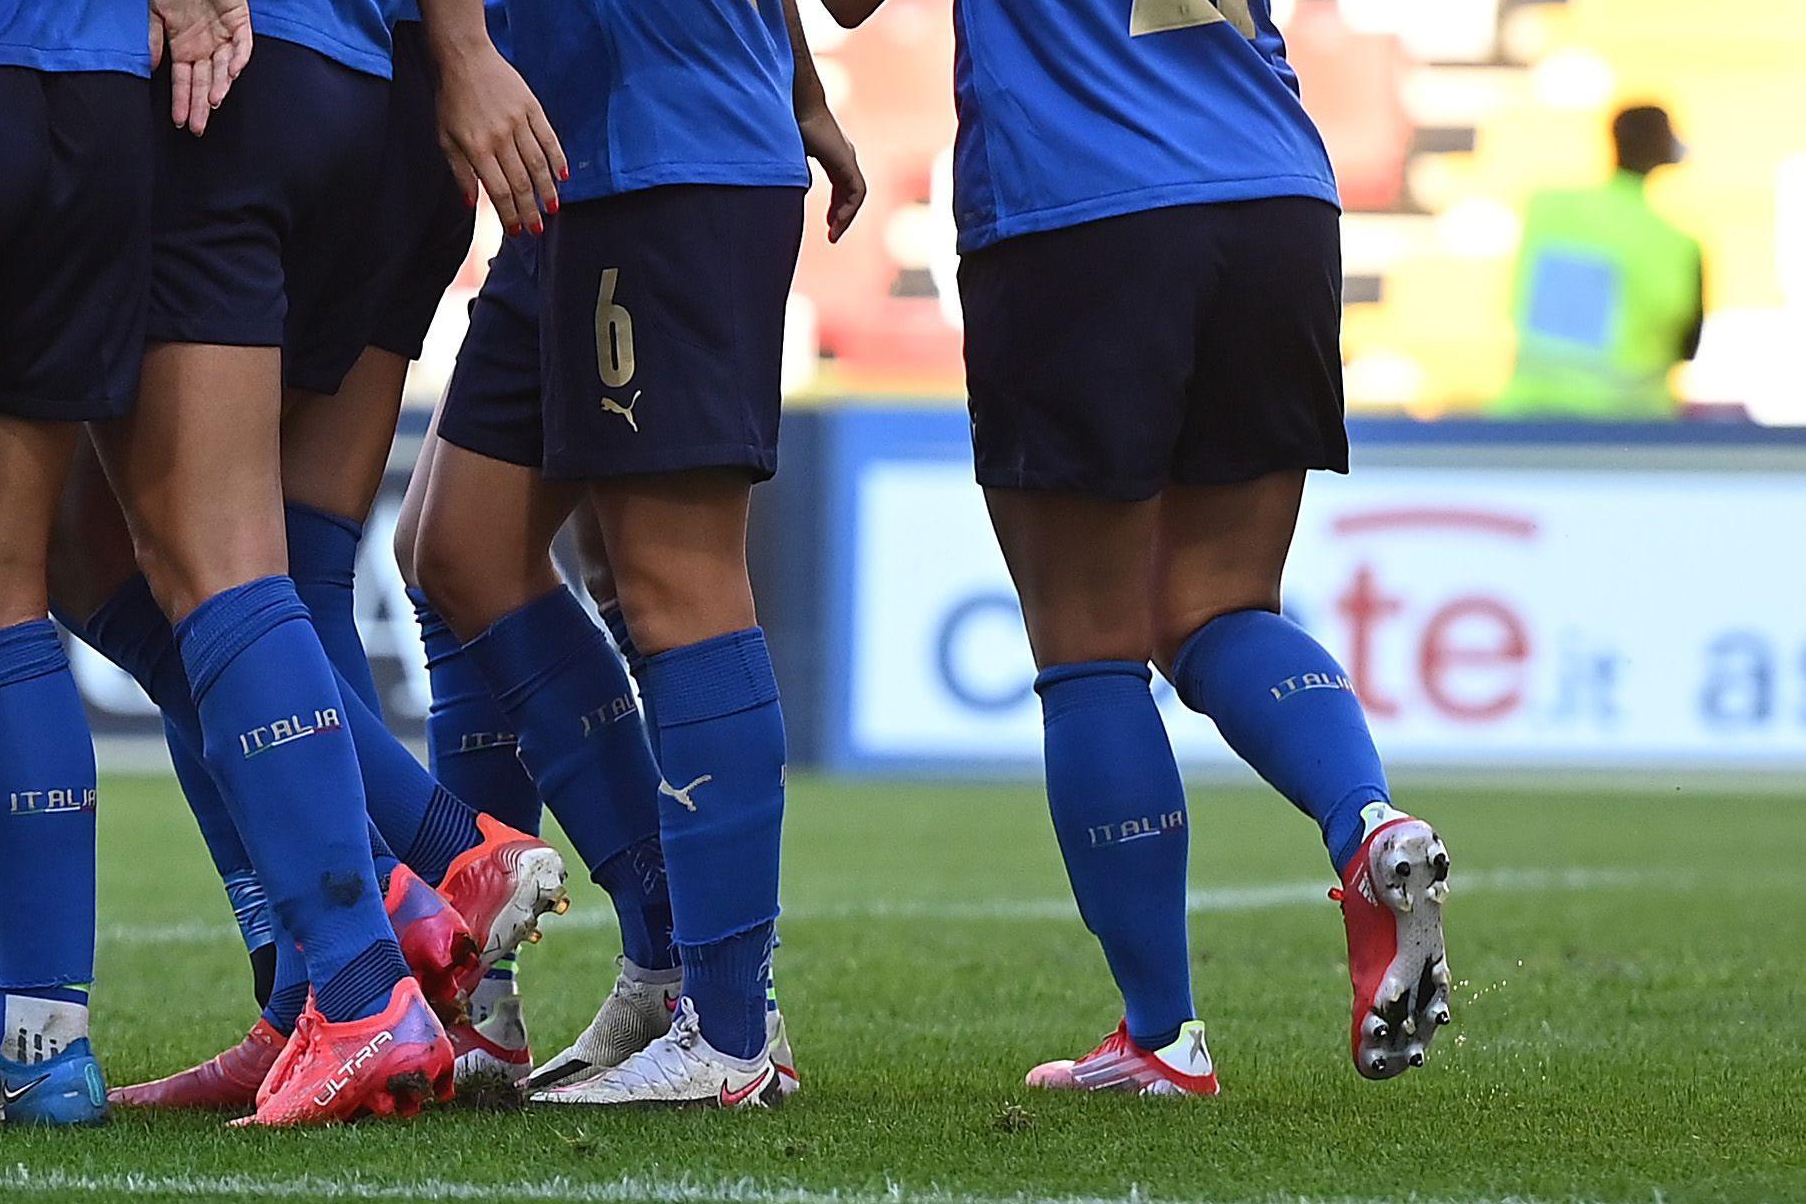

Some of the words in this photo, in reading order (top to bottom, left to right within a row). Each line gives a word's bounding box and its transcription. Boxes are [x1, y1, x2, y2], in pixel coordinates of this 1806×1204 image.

[594, 267, 636, 389] 6
[239, 707, 341, 756] ITALIA
[9, 788, 97, 812] ITALIA
[1088, 810, 1183, 846] ITALIA
[312, 1029, 394, 1107] ULTRA
